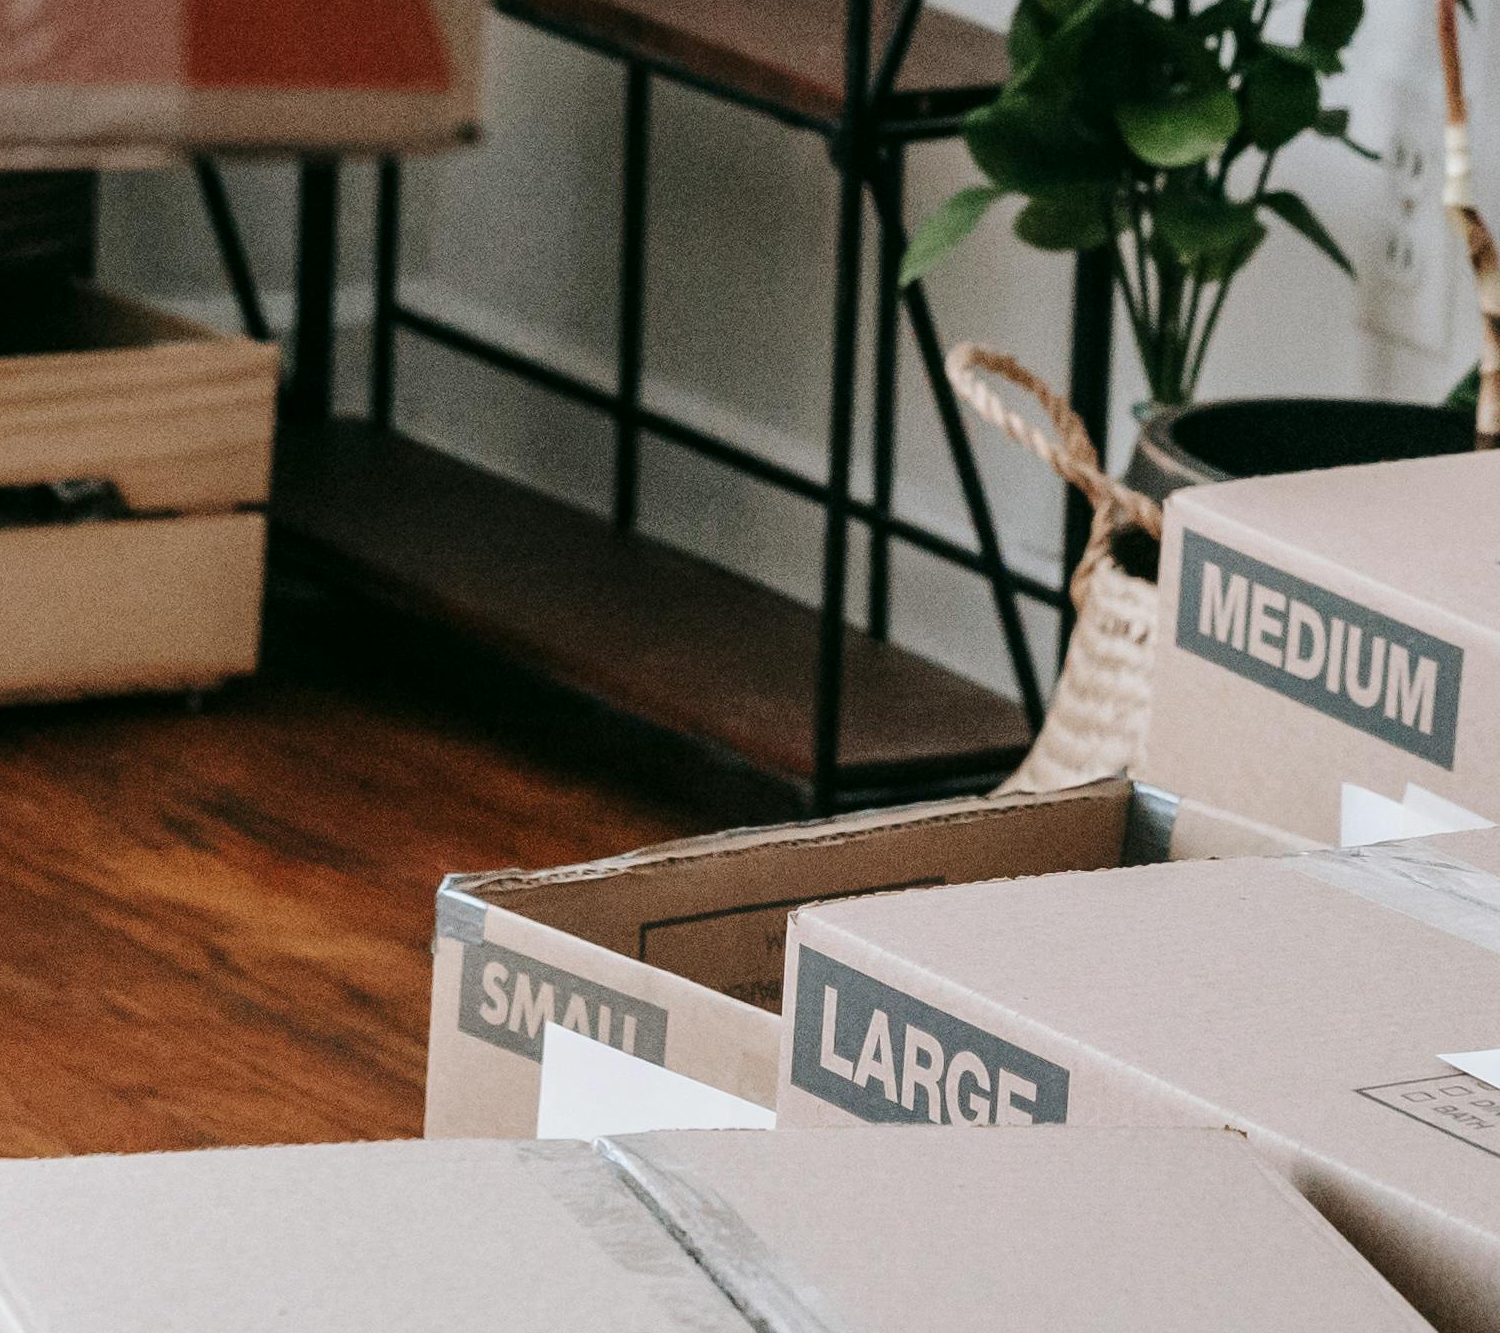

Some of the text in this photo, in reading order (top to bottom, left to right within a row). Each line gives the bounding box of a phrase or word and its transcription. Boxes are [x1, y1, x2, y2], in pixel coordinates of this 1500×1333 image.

[1198, 560, 1440, 736] MEDIUM
[819, 984, 1038, 1125] LARGE
[1432, 1105, 1496, 1131] BATH
